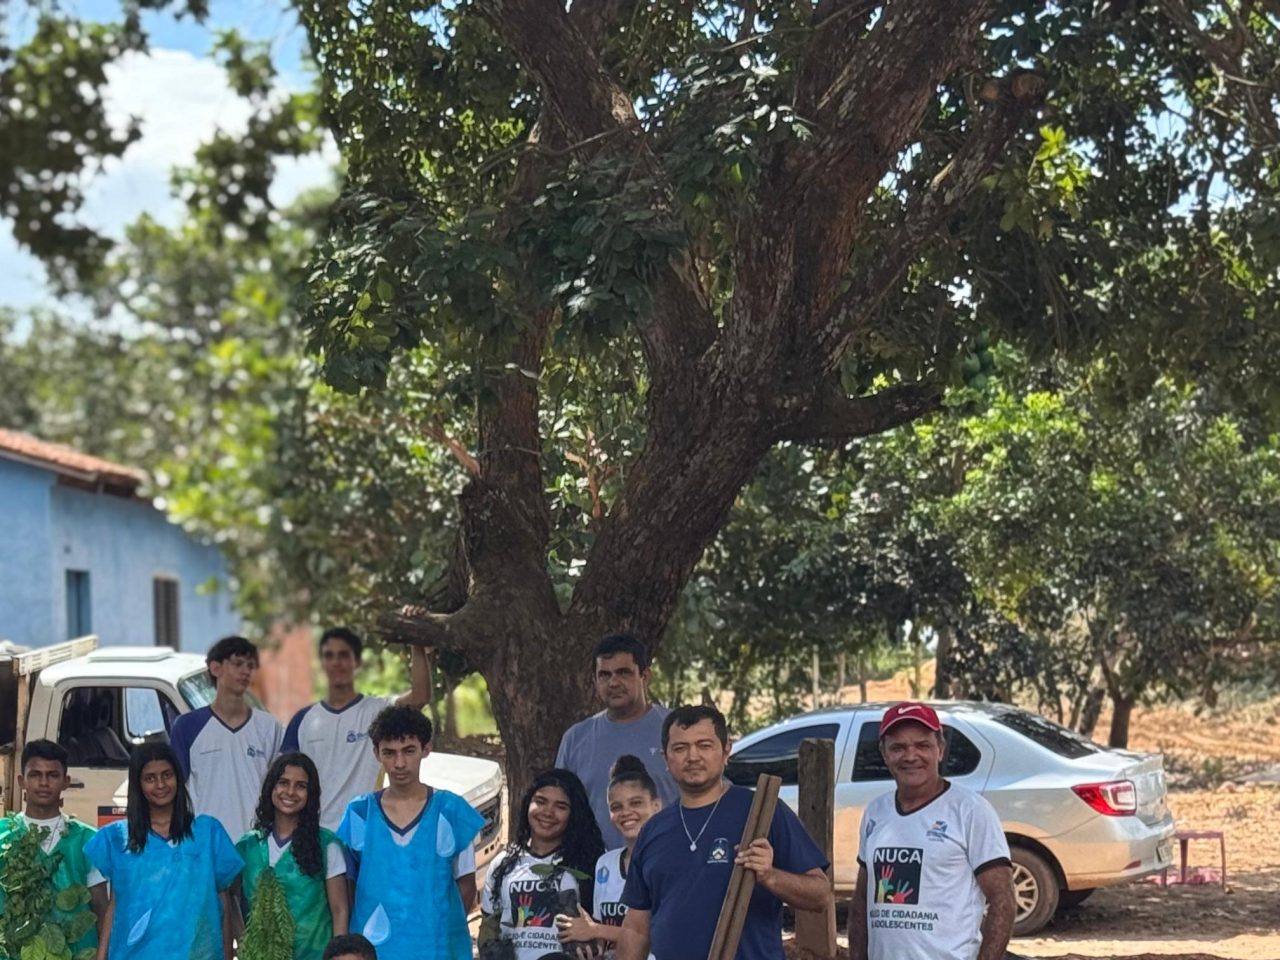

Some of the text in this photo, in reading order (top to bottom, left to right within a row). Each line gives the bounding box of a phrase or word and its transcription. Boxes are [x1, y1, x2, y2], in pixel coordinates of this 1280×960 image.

[874, 848, 921, 864] NUCA
[510, 880, 560, 893] NUCA
[600, 903, 627, 917] NUC
[892, 910, 939, 921] CIDADANIA
[516, 941, 560, 950] OLESCENTE
